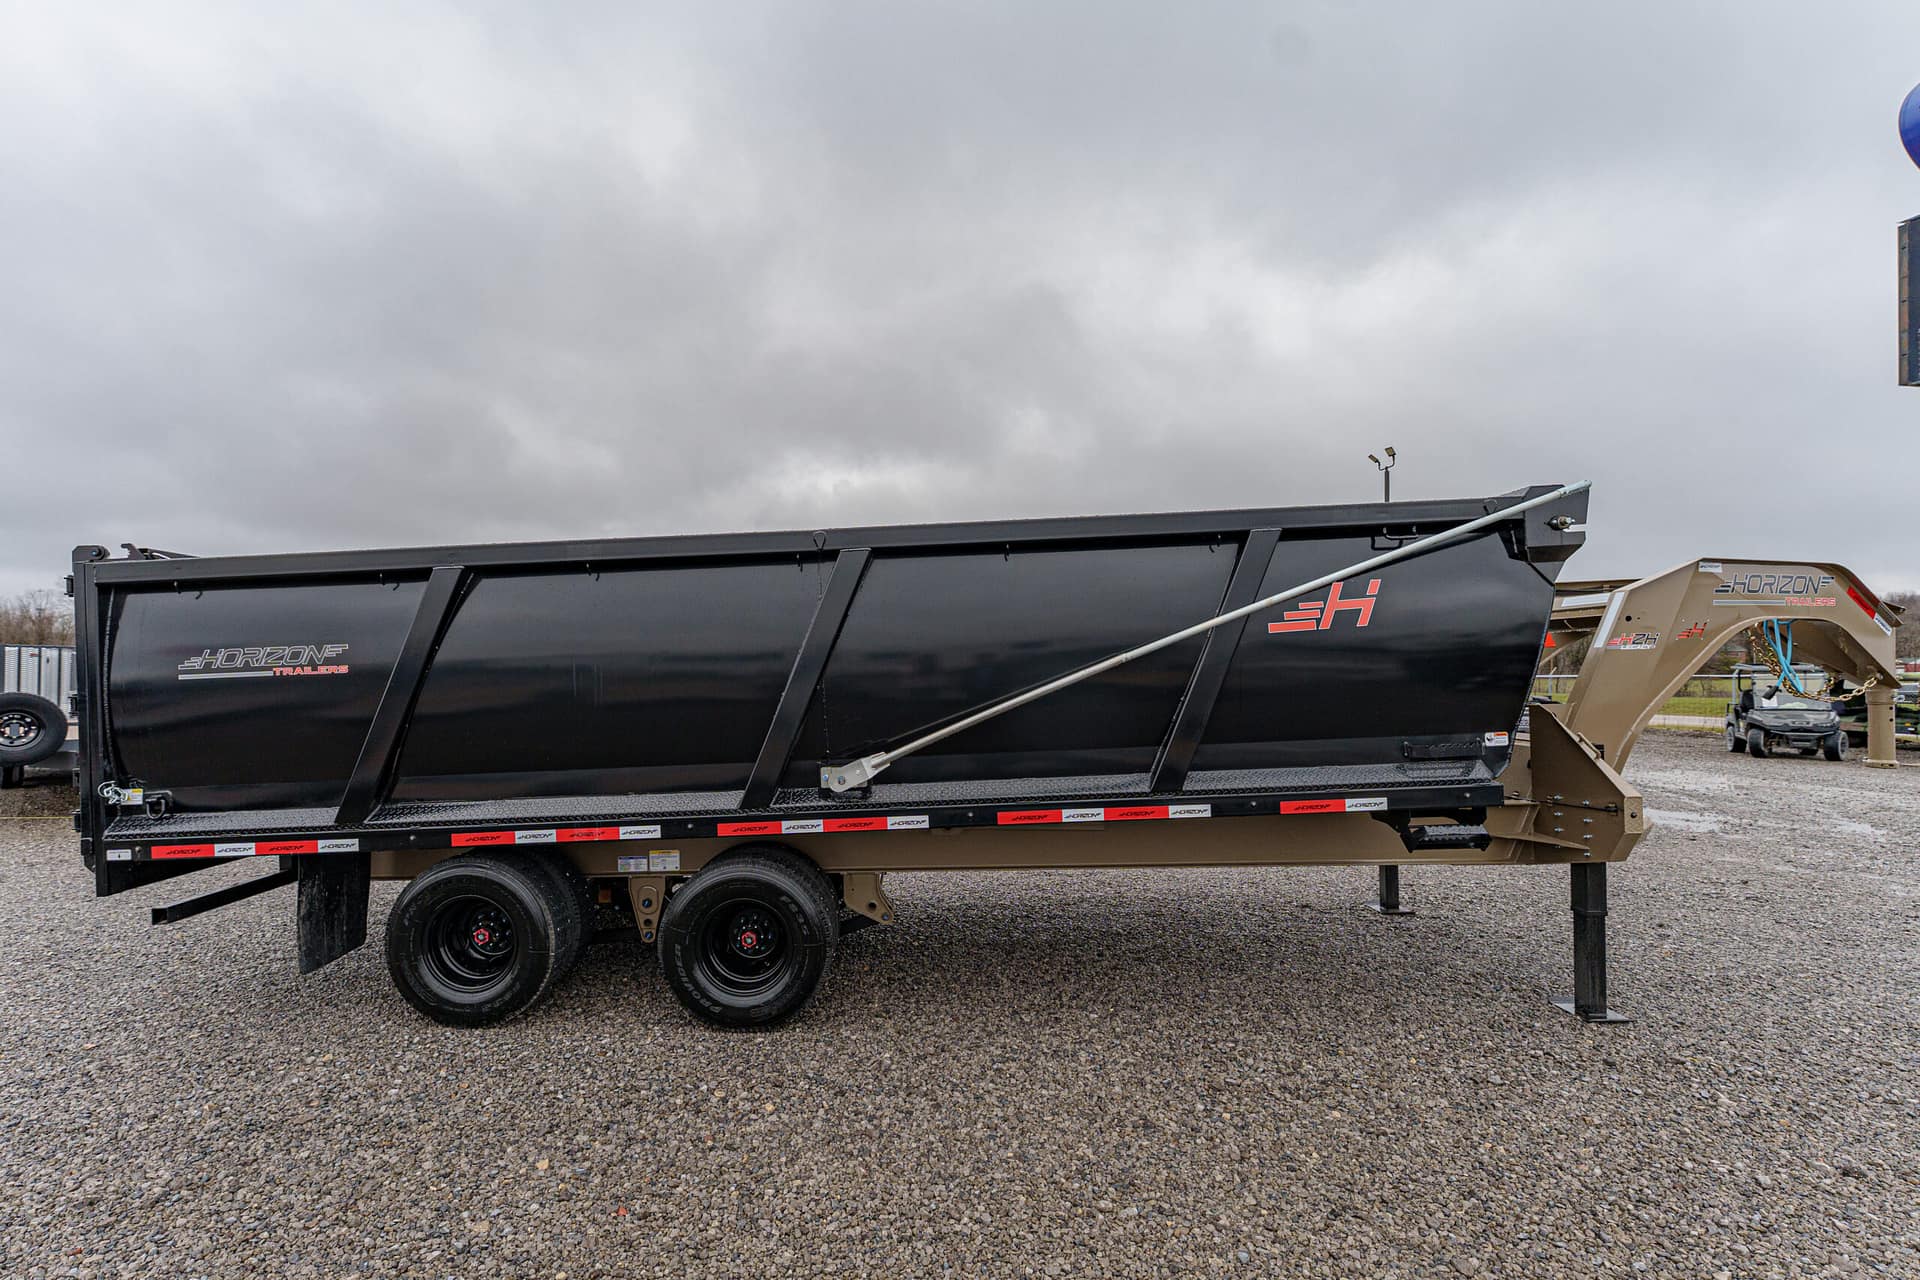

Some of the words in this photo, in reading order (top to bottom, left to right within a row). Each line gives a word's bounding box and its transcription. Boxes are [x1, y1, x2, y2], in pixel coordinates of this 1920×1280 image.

[1730, 574, 1821, 594] HORIZON
[1785, 596, 1837, 607] TRAILERS
[198, 644, 329, 669] HORIZON
[272, 665, 349, 676] TRAILERS
